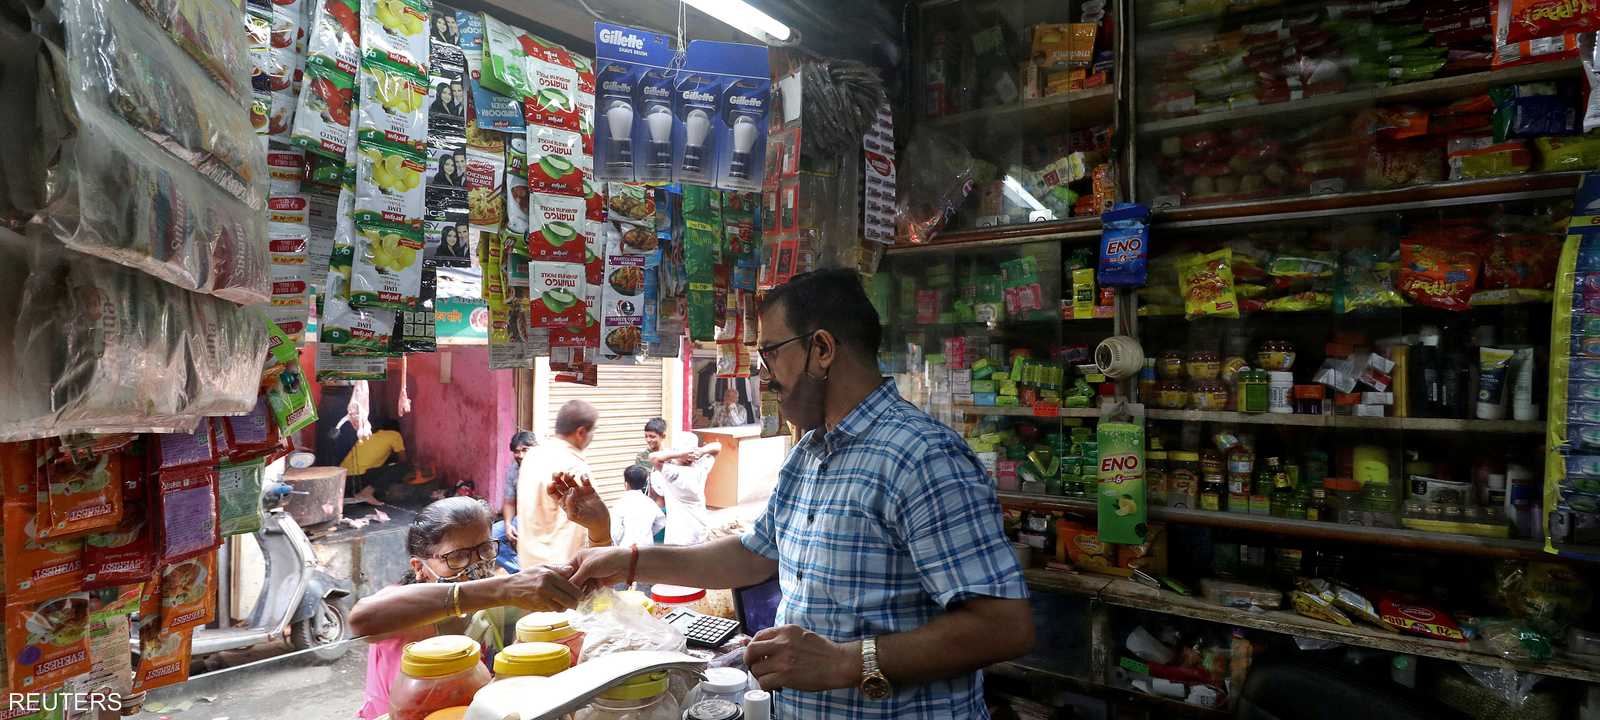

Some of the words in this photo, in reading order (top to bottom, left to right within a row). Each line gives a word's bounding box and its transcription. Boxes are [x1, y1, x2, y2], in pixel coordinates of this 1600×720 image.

[600, 29, 643, 50] Gillette
[603, 81, 631, 93] Gillette
[643, 86, 669, 97] Gillette
[682, 90, 715, 103] Gillette
[729, 95, 764, 108] Gillette
[320, 132, 346, 144] OMATO
[386, 131, 407, 142] priya
[383, 212, 404, 222] priya
[1106, 240, 1142, 256] ENO
[383, 284, 398, 292] LIME
[380, 293, 401, 302] priya
[353, 330, 374, 339] priya
[1102, 456, 1138, 472] ENO
[68, 504, 112, 521] EVEREST
[33, 560, 82, 579] EVEREST
[169, 608, 207, 626] EVEREST
[36, 652, 86, 675] EVEREST
[145, 659, 181, 680] EVEREST
